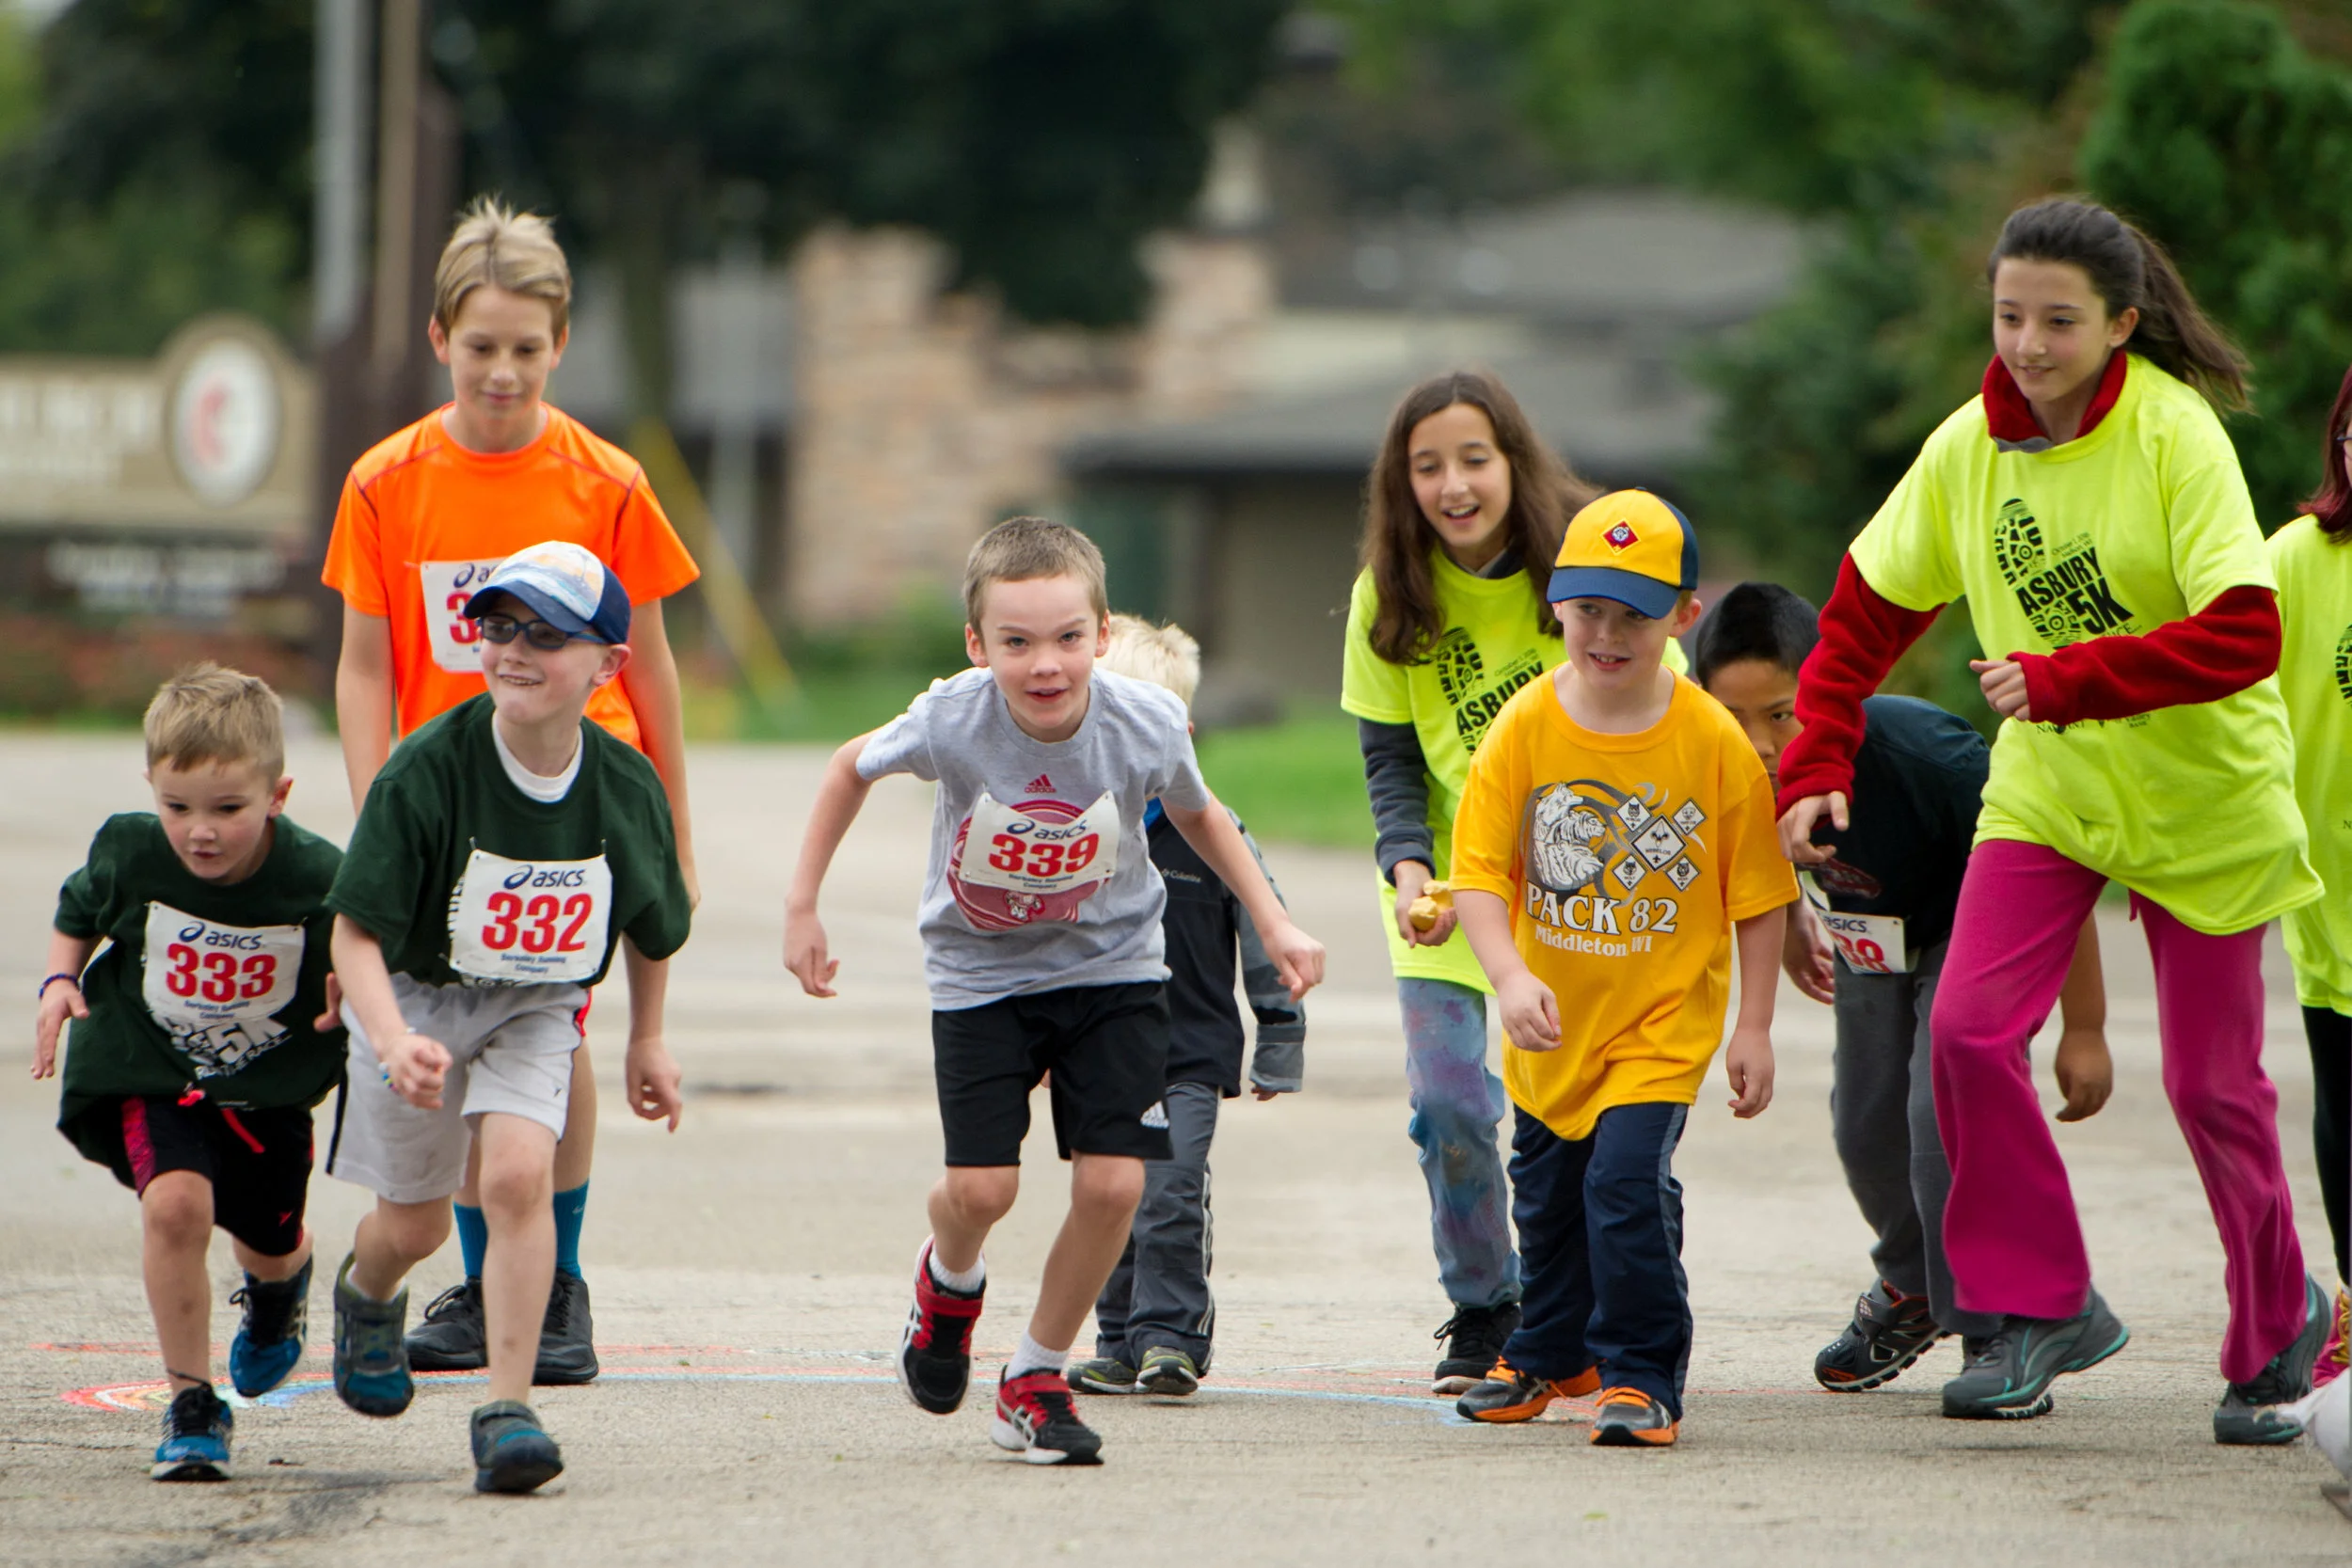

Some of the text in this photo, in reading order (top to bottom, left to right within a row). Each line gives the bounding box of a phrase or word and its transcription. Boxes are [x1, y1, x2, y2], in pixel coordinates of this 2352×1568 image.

[2015, 546, 2103, 617] ASBURY
[2066, 577, 2134, 634] 5K
[532, 868, 586, 888] asics
[989, 833, 1100, 878] 339
[481, 891, 593, 953] 332
[1525, 879, 1679, 936] PACK 82
[204, 930, 262, 950] asics
[1534, 924, 1653, 957] Middleton WI
[166, 942, 278, 1004] 333
